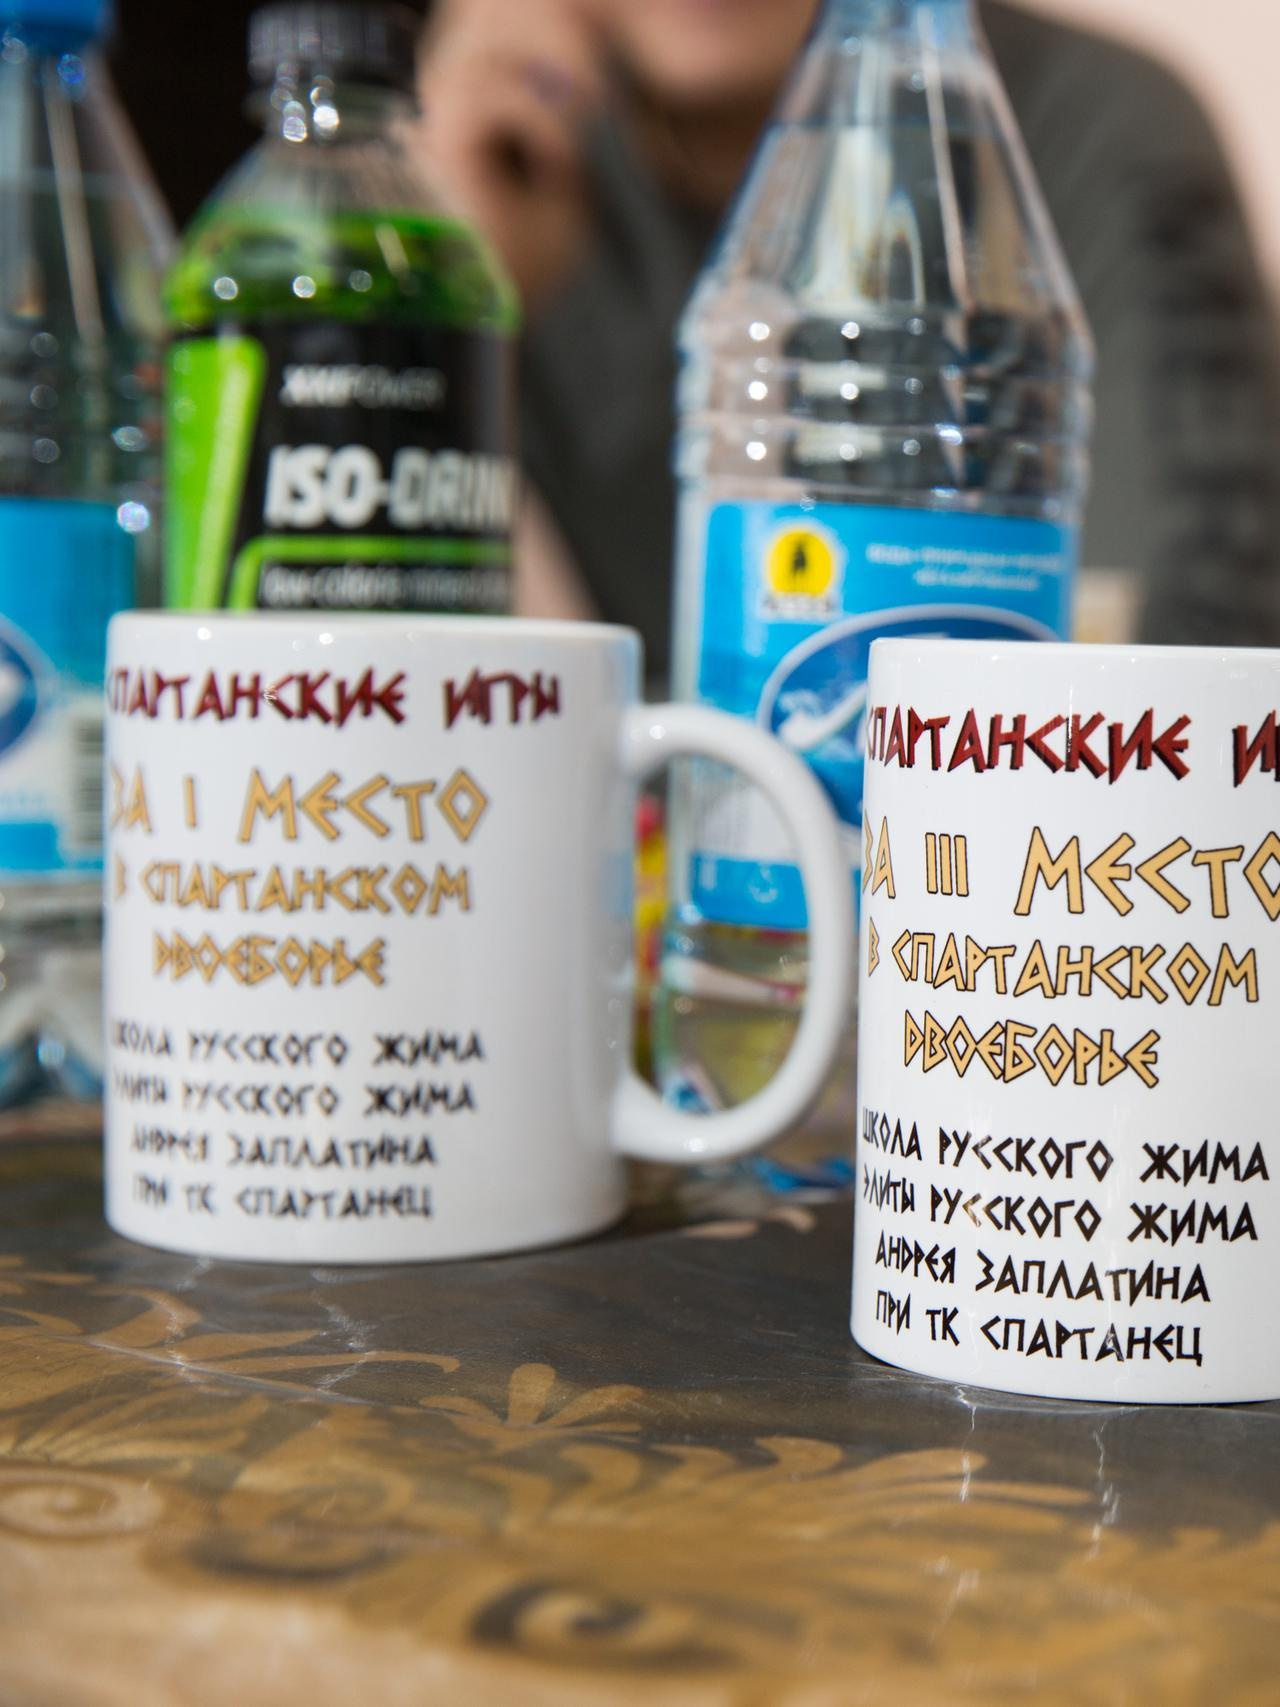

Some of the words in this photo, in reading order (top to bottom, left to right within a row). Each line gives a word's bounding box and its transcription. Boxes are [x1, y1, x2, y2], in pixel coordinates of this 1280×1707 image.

[264, 444, 516, 529] ISO-DRIN
[443, 668, 562, 730] ИГРЫ
[865, 703, 1192, 785] СПАРТАНСКИЕ
[236, 766, 490, 845] МЕСТО
[139, 859, 473, 919] СПАРТАНСКОМ
[861, 809, 897, 900] ЗА
[924, 831, 970, 898] III
[153, 929, 388, 989] ДВОЕБОРЬЕ
[868, 915, 881, 978] В
[891, 929, 1260, 1008] СПАРТАНСКОМ
[188, 1029, 349, 1067] РУССКОГО
[371, 1029, 486, 1067] ЖИМА
[904, 1009, 1161, 1090] ДВОЕБОРЬЕ
[182, 1078, 339, 1117] РУССКОГО
[363, 1079, 478, 1119] ЖИМА
[227, 1130, 438, 1170] ЗАПЛАТИНА
[862, 1105, 923, 1161] ШКОЛА
[938, 1125, 1114, 1182] РУССКОГО
[1139, 1140, 1271, 1187] ЖИМА
[183, 1181, 216, 1216] ТК
[235, 1183, 436, 1221] СПАРТАНЕЦ
[862, 1162, 916, 1215] ЭЛИТЫ
[930, 1183, 1102, 1243] РУССКОГО
[1127, 1200, 1258, 1247] ЖИМА
[874, 1229, 957, 1284] АНДРЕЯ
[974, 1248, 1211, 1308] ЗАПЛАТИНА
[876, 1288, 912, 1336] ПРИ
[925, 1306, 961, 1347] ТК
[979, 1314, 1203, 1367] СПАРТАНЕЦ
